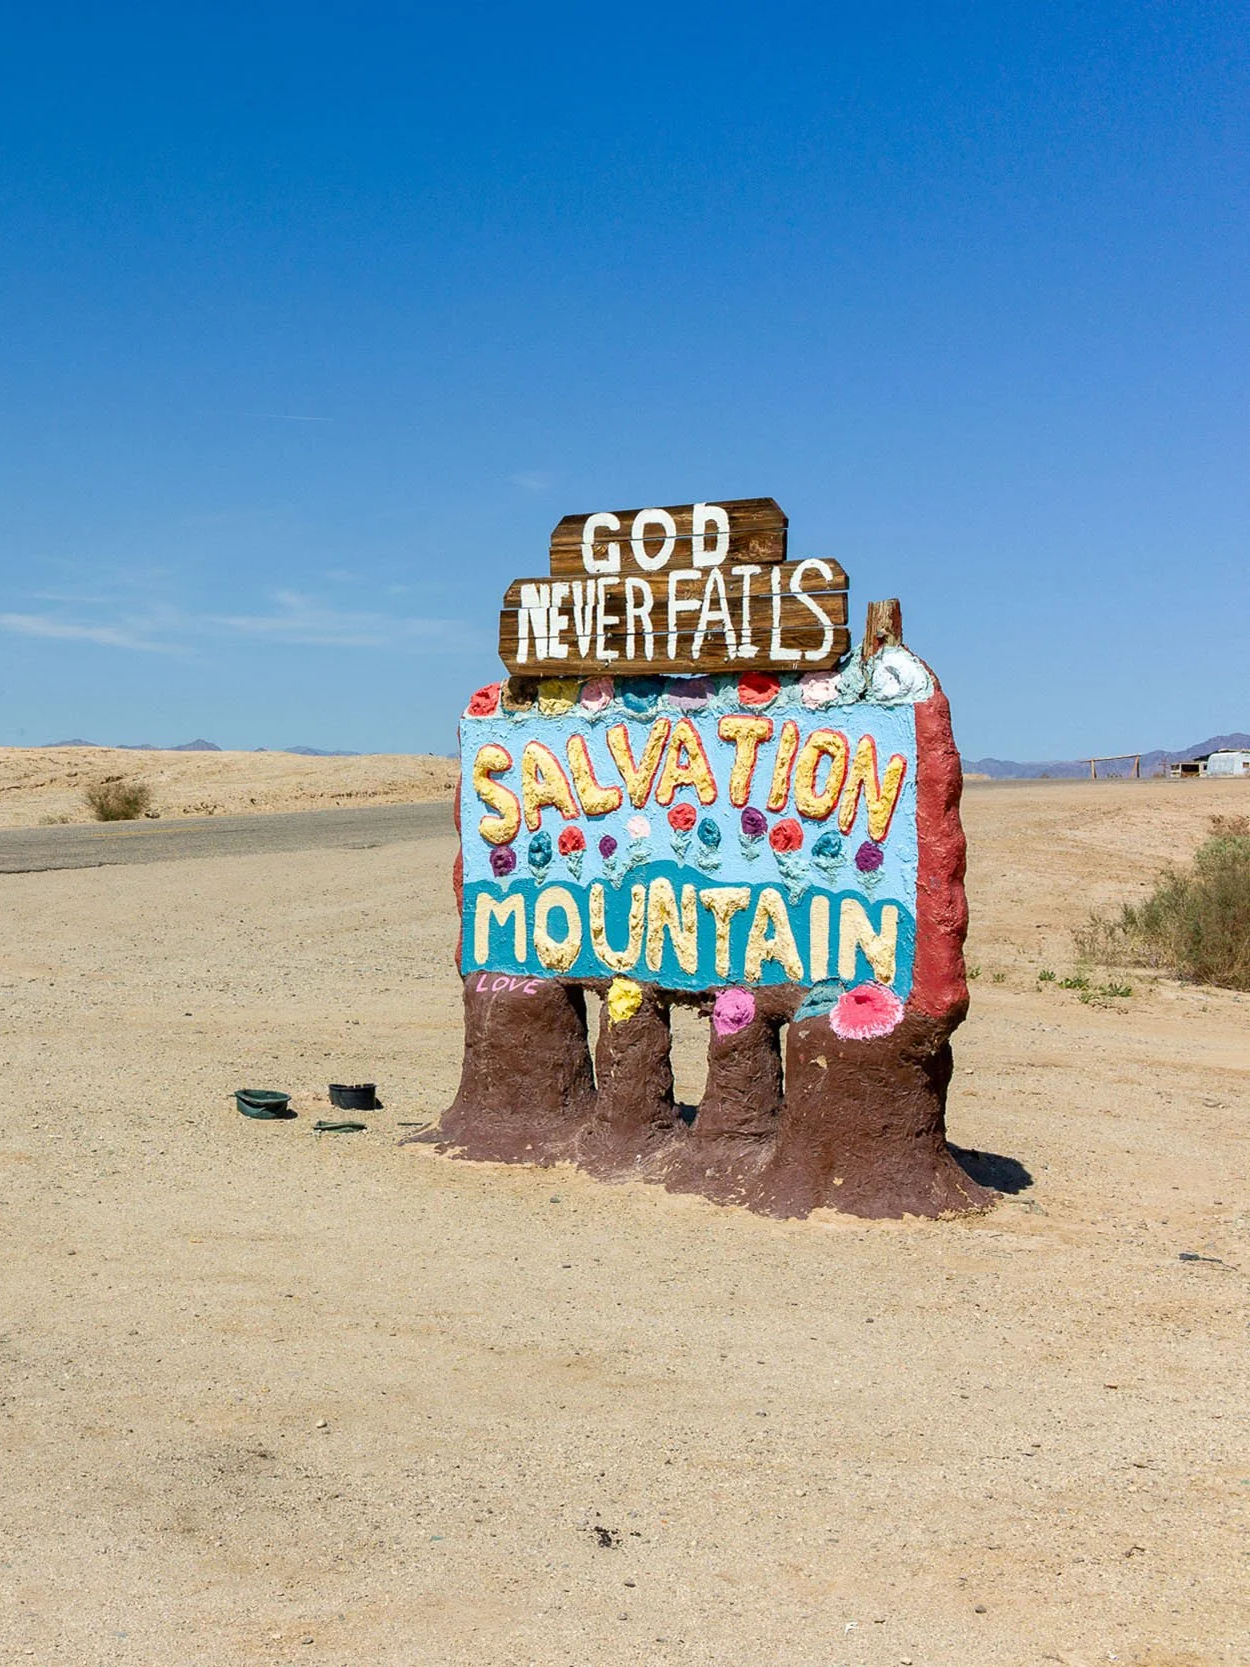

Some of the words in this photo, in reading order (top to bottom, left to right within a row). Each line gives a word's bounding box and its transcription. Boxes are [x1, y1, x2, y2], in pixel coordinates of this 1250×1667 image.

[581, 502, 730, 574] GOD
[516, 576, 655, 664] NEVER
[667, 557, 835, 662] FAILS
[472, 714, 907, 845] SALVATION
[473, 877, 899, 986] MOUNTAIN
[475, 973, 545, 996] LOVE
